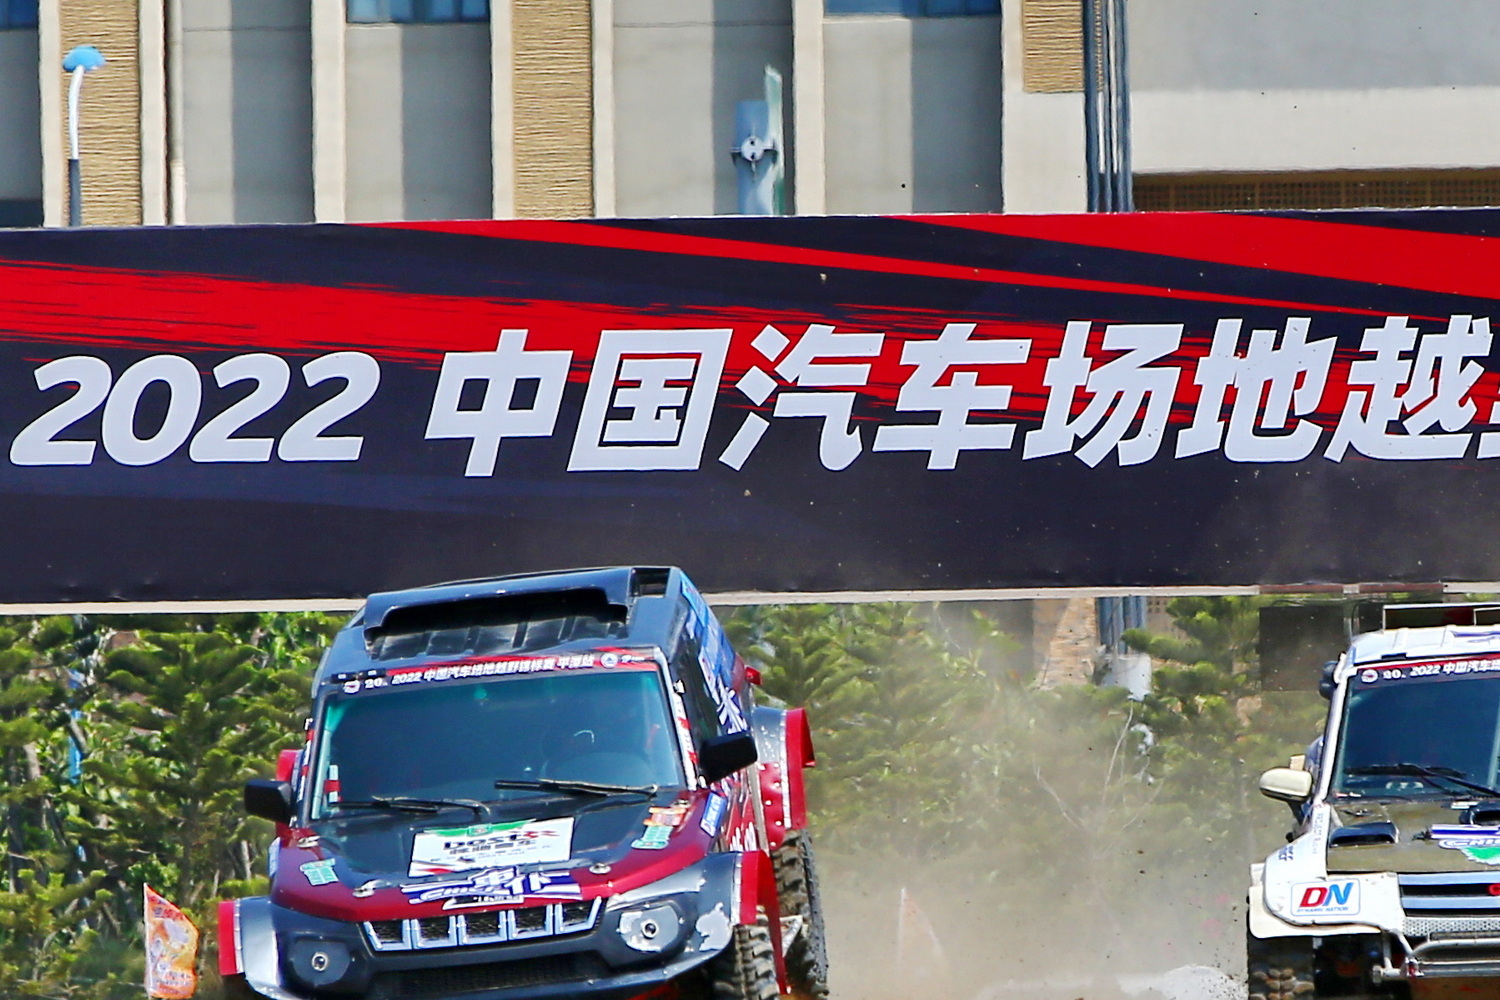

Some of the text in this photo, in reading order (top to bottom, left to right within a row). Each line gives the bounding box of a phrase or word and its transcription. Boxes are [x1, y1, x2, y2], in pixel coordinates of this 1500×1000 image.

[9, 350, 381, 466] 2022
[391, 672, 422, 685] 2022
[1299, 882, 1354, 908] DN
